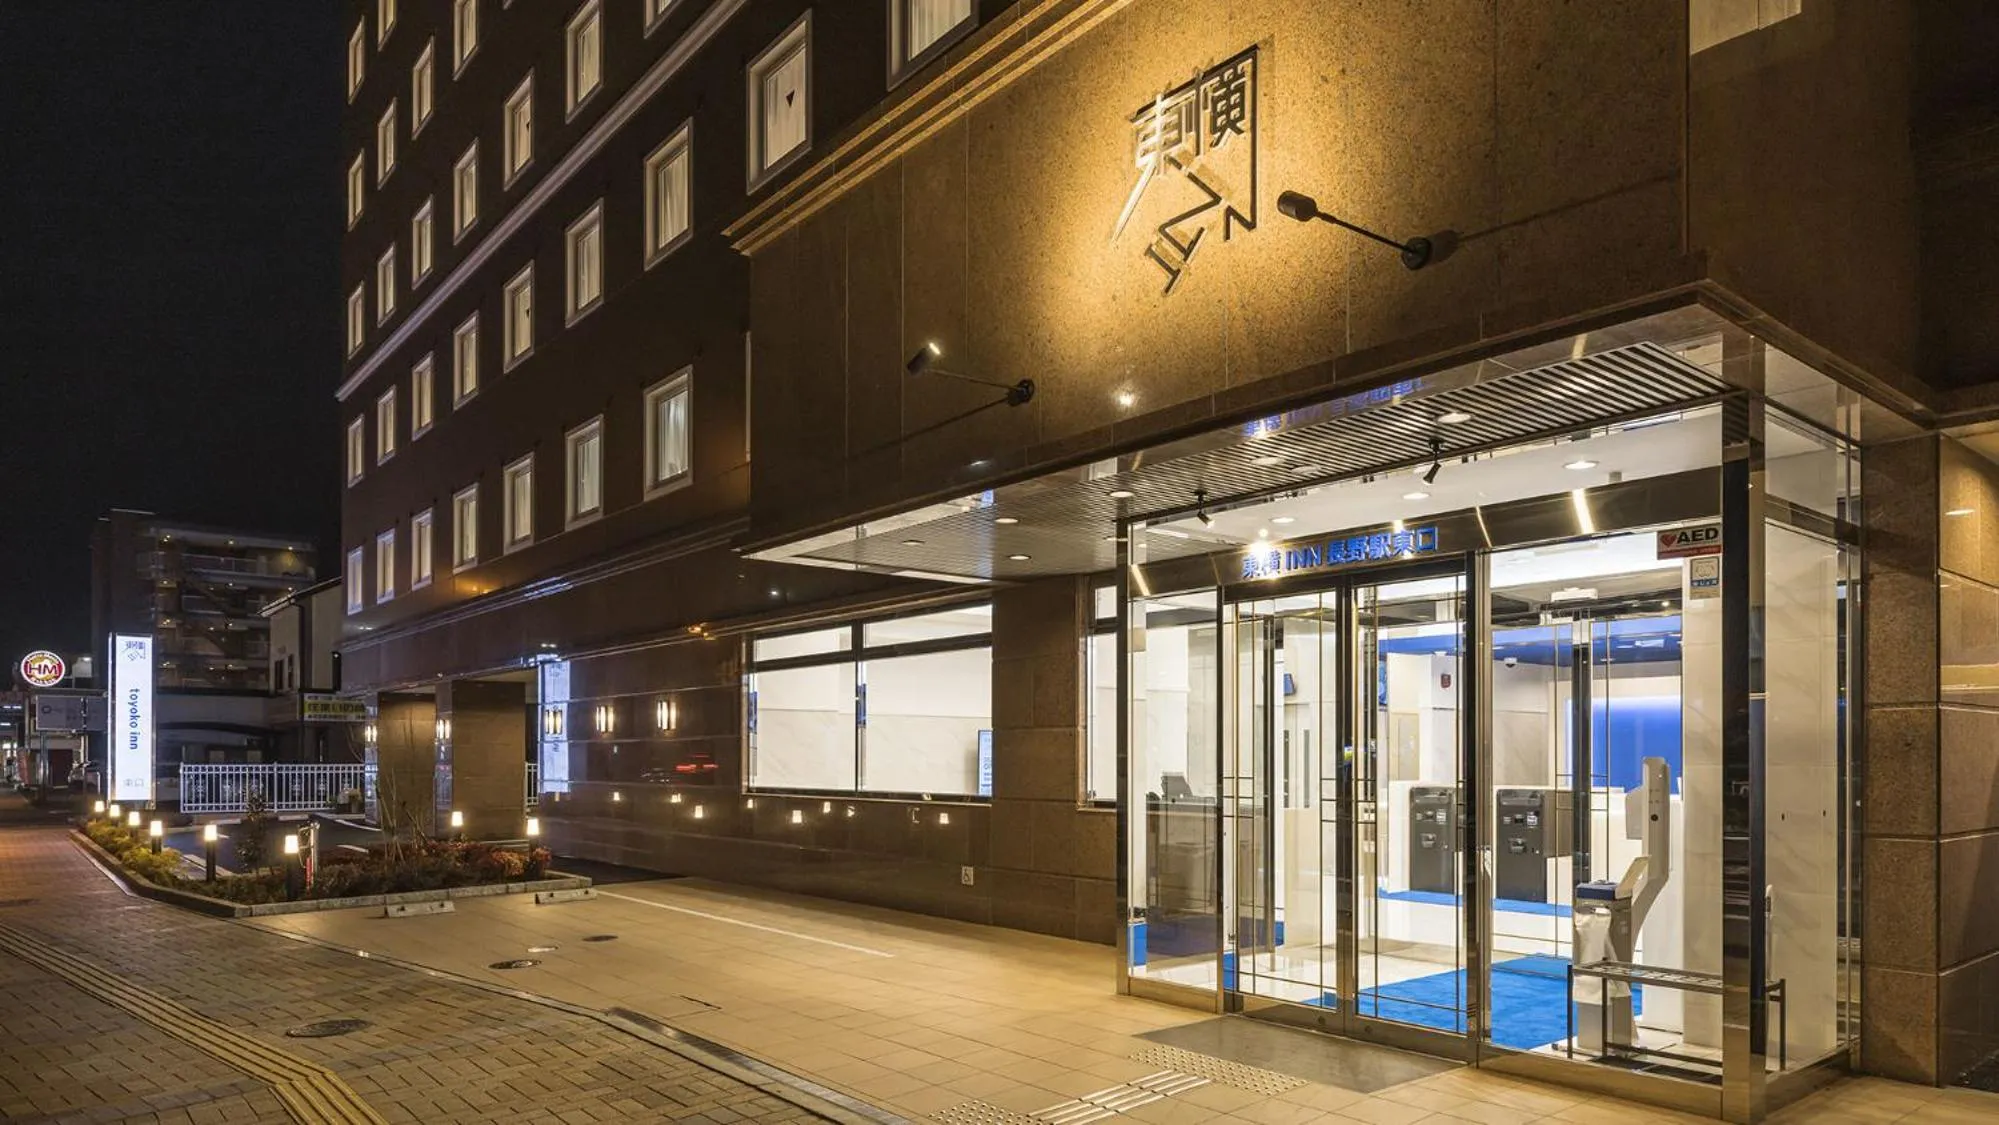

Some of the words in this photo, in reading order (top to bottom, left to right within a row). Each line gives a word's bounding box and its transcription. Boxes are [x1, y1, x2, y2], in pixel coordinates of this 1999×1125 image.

[1677, 527, 1719, 544] AED
[1285, 545, 1323, 571] INN
[28, 663, 58, 676] HM
[128, 688, 140, 728] toyoko
[129, 730, 141, 750] inn
